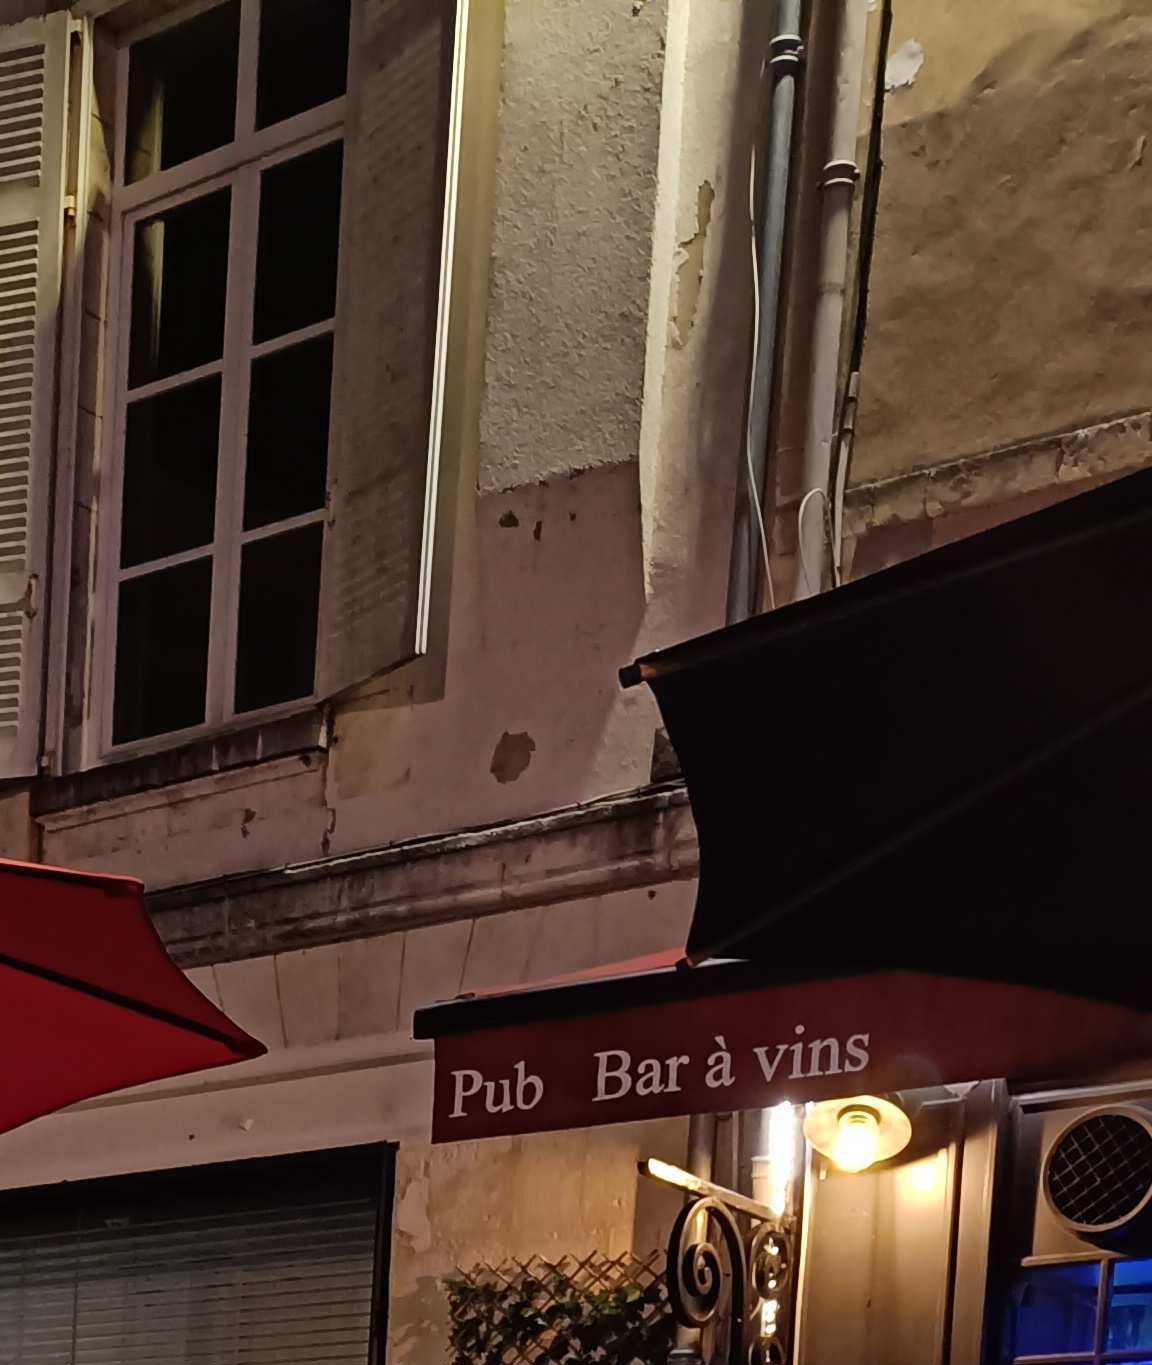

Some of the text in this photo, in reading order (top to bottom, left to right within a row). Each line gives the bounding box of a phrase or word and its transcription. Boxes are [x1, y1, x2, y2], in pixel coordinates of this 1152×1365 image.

[448, 1024, 871, 1118] Pub Bar à vins
